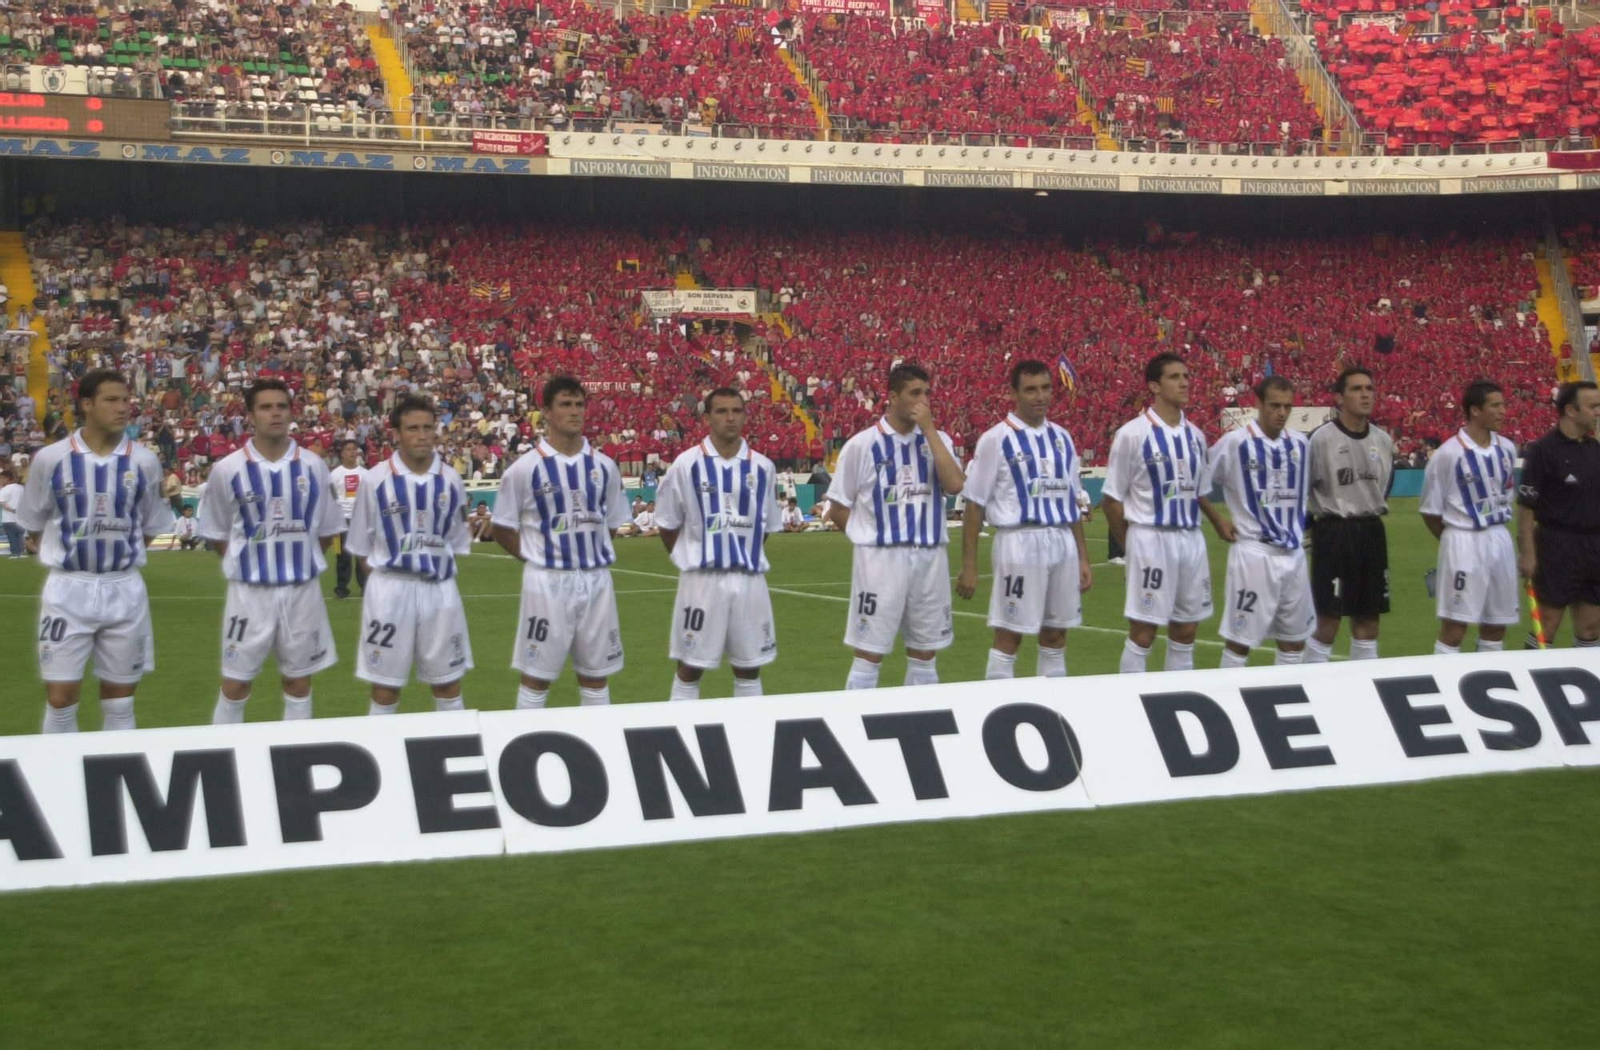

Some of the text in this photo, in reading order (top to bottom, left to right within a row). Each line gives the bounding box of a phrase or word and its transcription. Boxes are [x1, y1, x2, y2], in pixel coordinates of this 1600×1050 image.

[142, 144, 250, 163] MAZ
[290, 151, 394, 169] MAZ
[432, 156, 530, 174] MAZ
[574, 161, 668, 177] INFORMACION
[697, 165, 786, 180] INFORMACION
[814, 169, 900, 184] INFORMACION
[927, 172, 1011, 186] INFORMACION
[1036, 175, 1117, 189] INFORMACION
[1142, 178, 1219, 192] INFORMACION
[1465, 177, 1557, 192] INFORMACION
[1243, 181, 1322, 194] INFORMACION
[1352, 180, 1437, 194] INFORMACION
[1004, 574, 1024, 599] 14
[1142, 566, 1163, 590] 19
[1331, 577, 1341, 597] 1
[1454, 571, 1466, 591] 6
[857, 591, 877, 616] 15
[1236, 588, 1258, 613] 12
[40, 615, 67, 642] 20
[227, 614, 248, 642] 11
[527, 615, 549, 642] 16
[684, 606, 704, 632] 10
[366, 619, 396, 648] 22
[1139, 684, 1336, 778] DE
[1373, 666, 1600, 758] ESP
